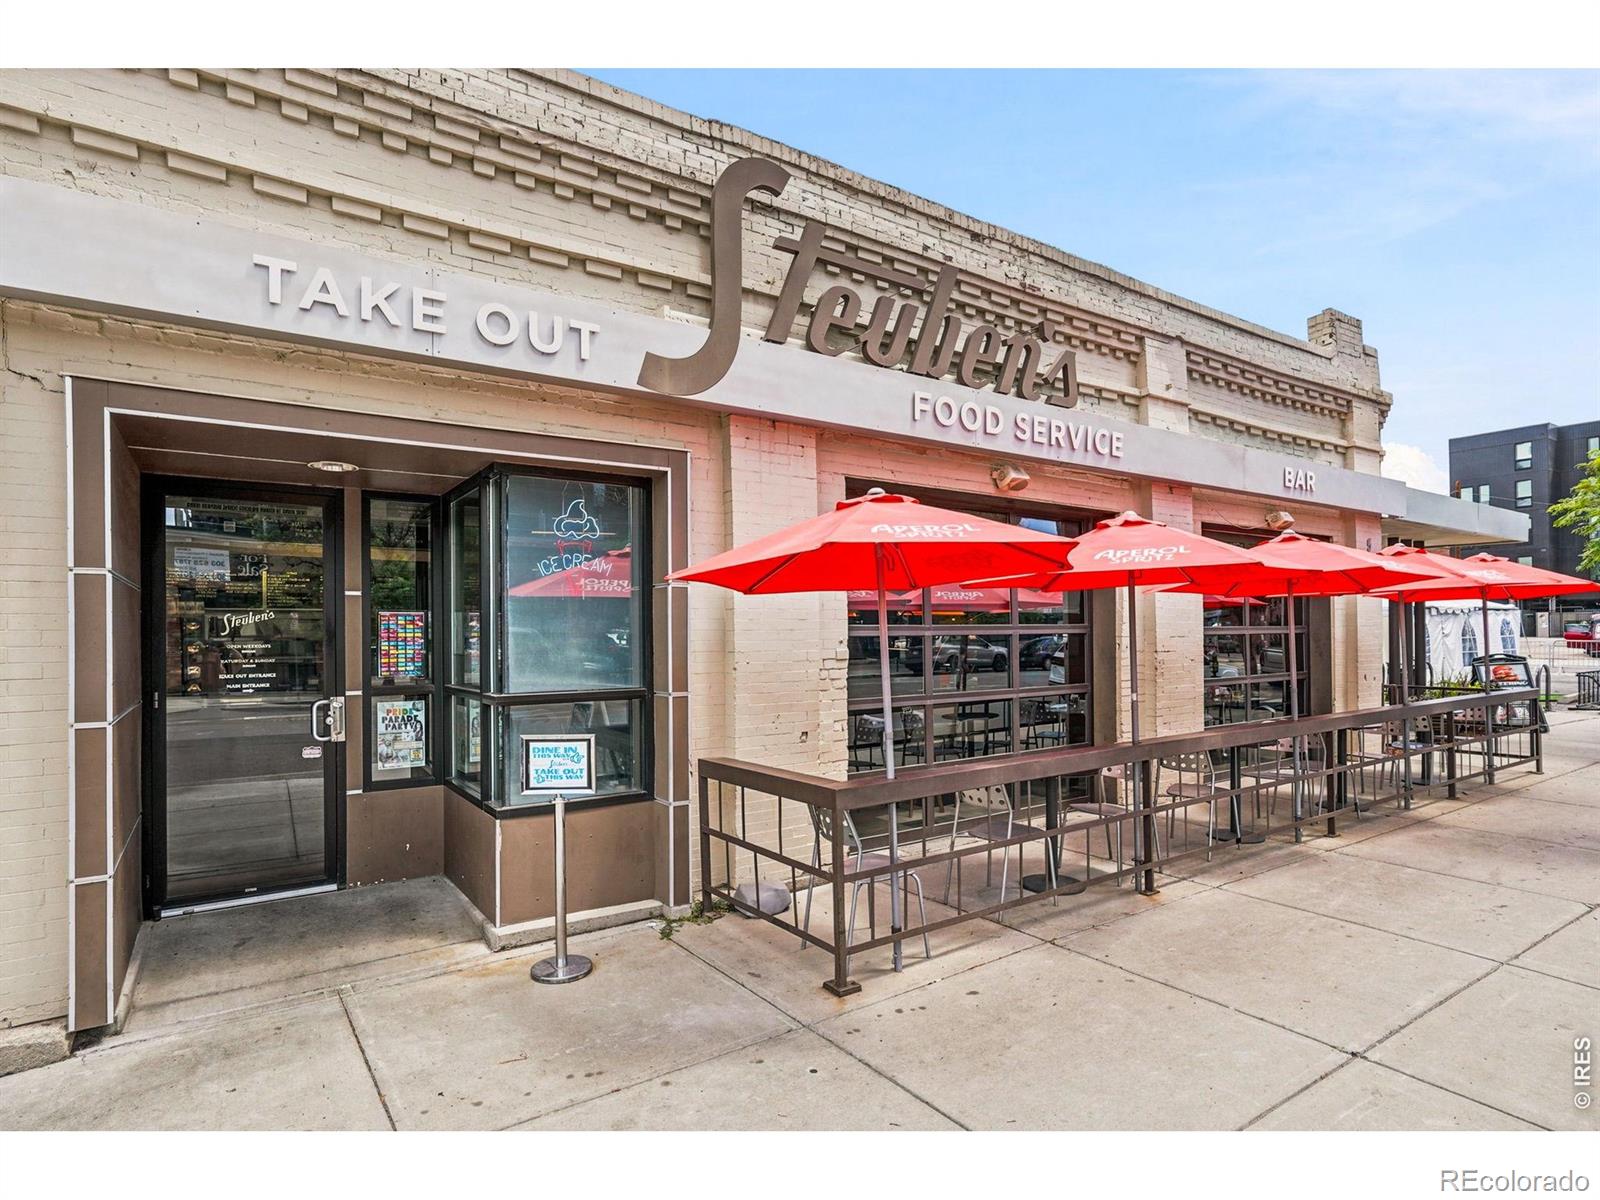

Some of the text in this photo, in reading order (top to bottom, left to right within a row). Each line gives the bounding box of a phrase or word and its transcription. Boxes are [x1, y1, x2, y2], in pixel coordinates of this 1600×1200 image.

[637, 157, 1079, 409] Steuben's
[252, 254, 601, 361] TAKE OUT
[913, 391, 1125, 458] FOOD SERVICE
[1283, 466, 1316, 493] BAR
[871, 524, 982, 533] APEROL
[1093, 545, 1192, 560] APEROL
[1110, 553, 1175, 564] SPRITZ
[537, 553, 613, 577] ICE CREAM
[220, 610, 276, 636] Steuben's
[381, 715, 419, 724] PARADE
[386, 708, 414, 716] PRIDE
[384, 722, 415, 731] PARTY
